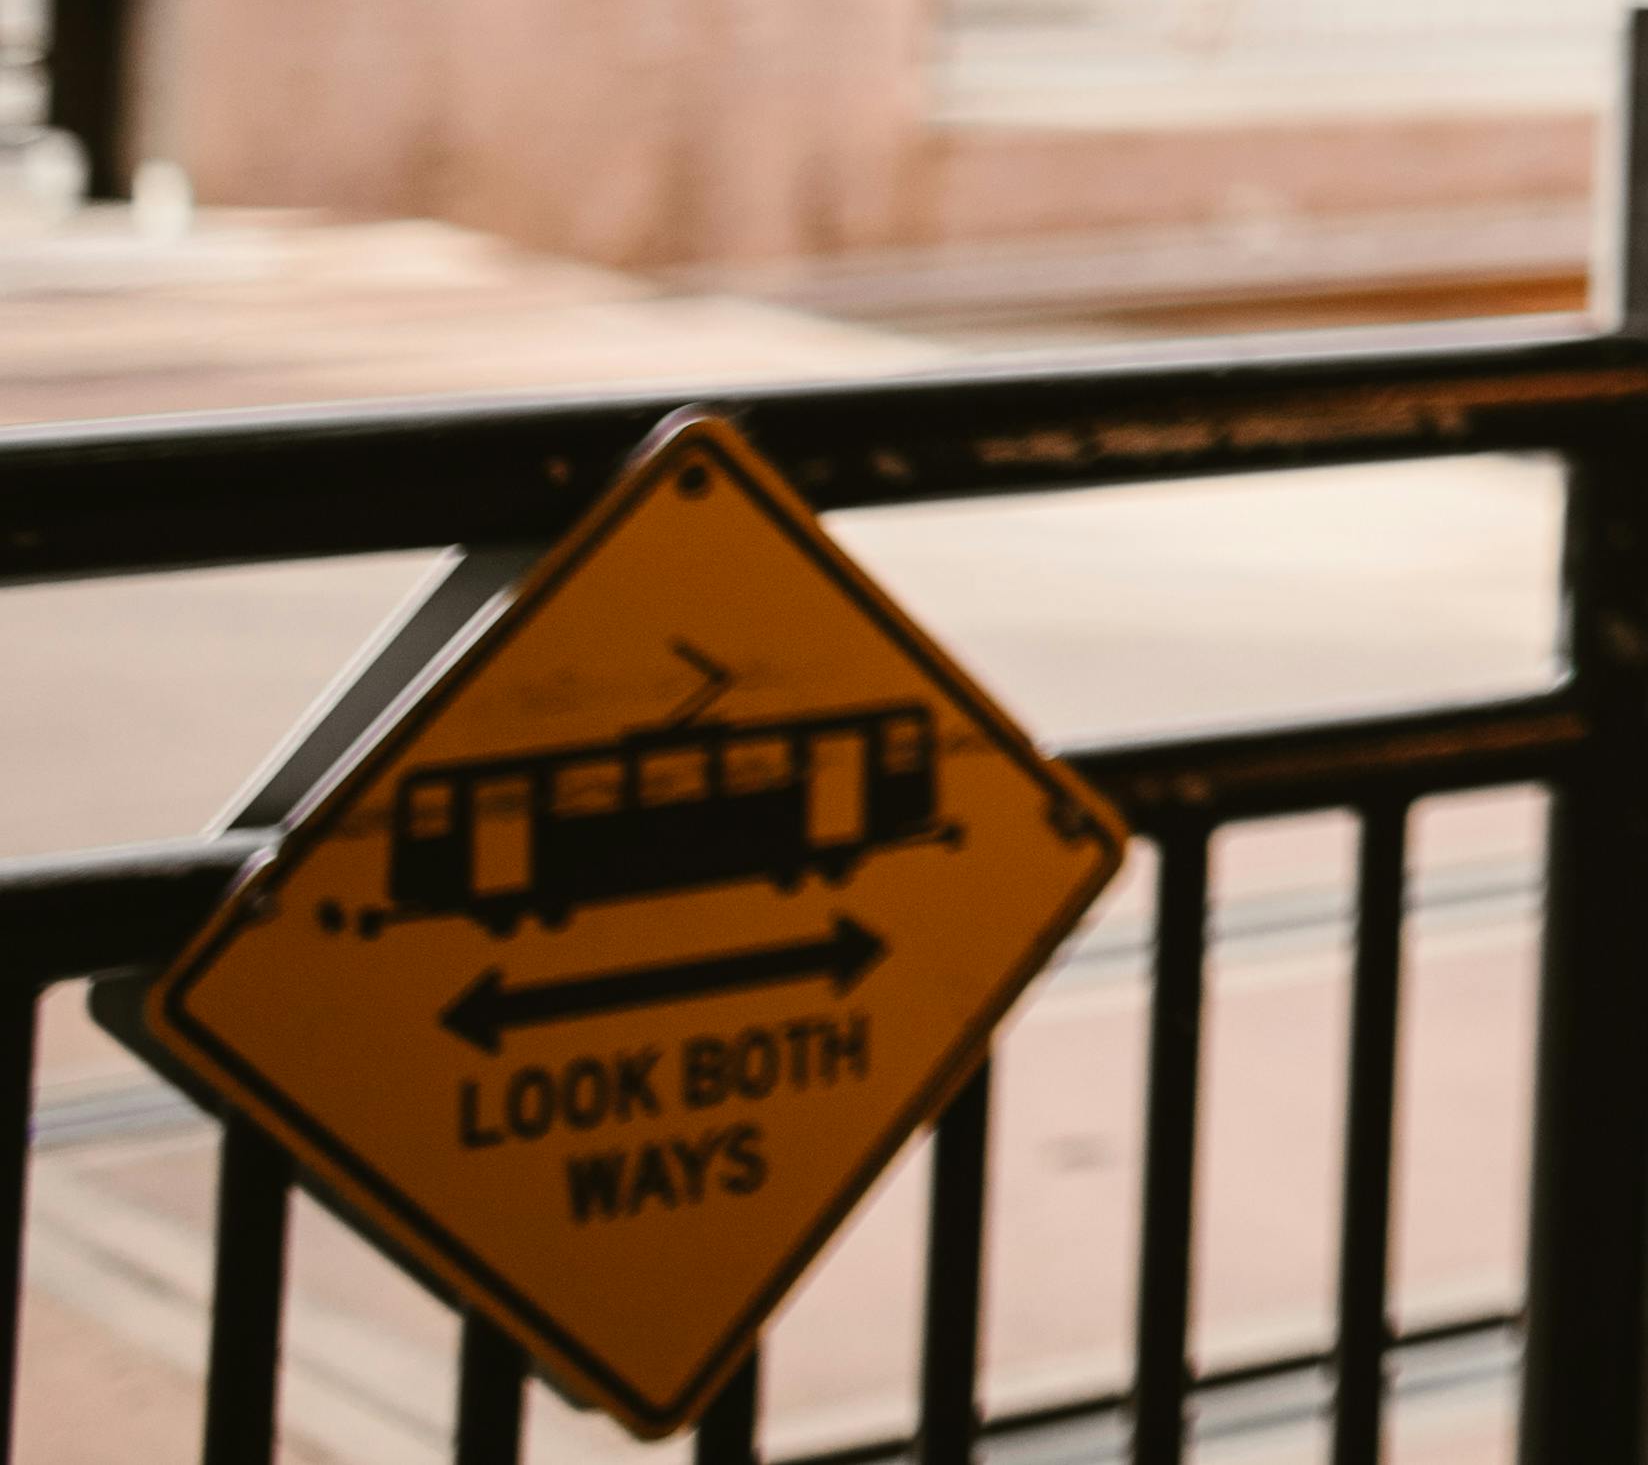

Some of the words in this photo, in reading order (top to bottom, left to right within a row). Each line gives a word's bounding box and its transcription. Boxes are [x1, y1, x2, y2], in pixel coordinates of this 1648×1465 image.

[457, 1044, 663, 1150] LOOK
[681, 1012, 872, 1110] BOTH
[566, 1120, 767, 1227] WAYS
